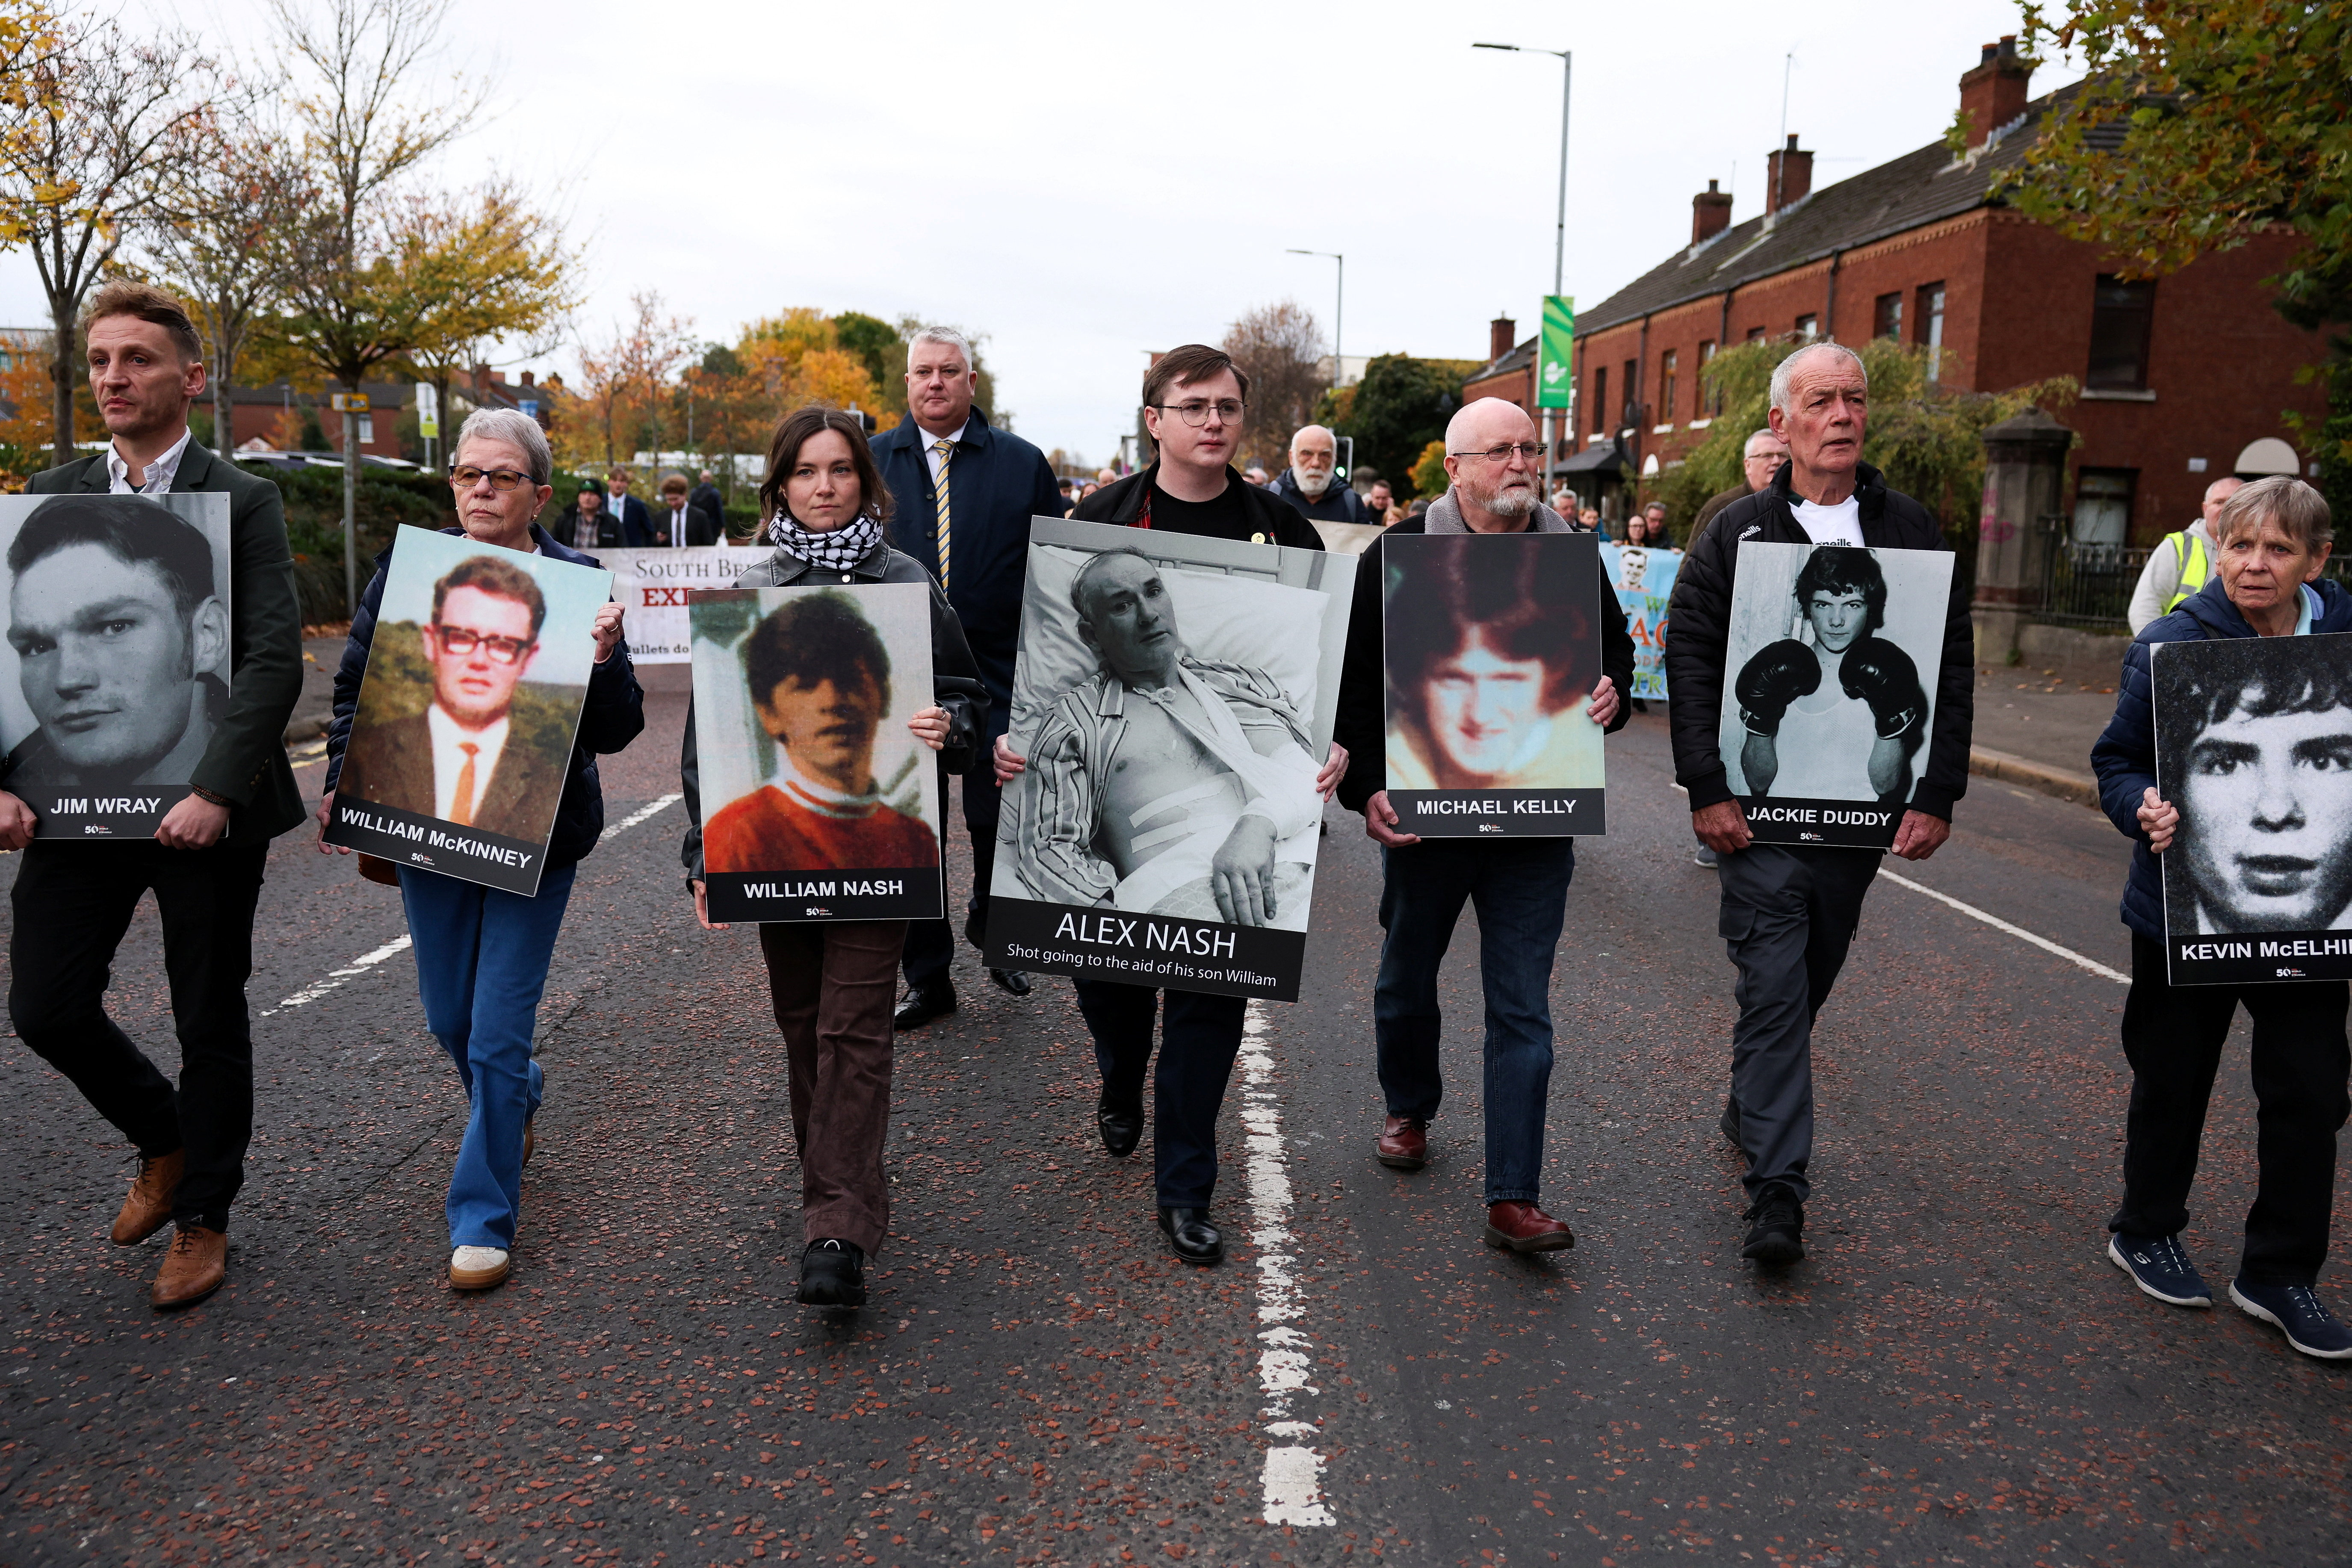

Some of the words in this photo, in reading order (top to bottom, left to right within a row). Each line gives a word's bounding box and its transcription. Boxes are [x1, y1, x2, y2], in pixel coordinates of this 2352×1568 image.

[1815, 538, 1852, 547] 'neills
[674, 643, 689, 654] do
[50, 798, 87, 814] JIM
[95, 798, 161, 813] WRAY
[1417, 800, 1508, 814] MICHAEL
[1513, 800, 1577, 813] KELLY
[1746, 807, 1817, 823] JACKIE
[1823, 810, 1892, 826] DUDDY
[342, 807, 425, 842] WILLIAM
[428, 830, 532, 868] McKINNEY
[411, 853, 423, 862] 50
[743, 881, 836, 898] WILLIAM
[843, 880, 903, 896] NASH
[1055, 913, 1138, 947] ALEX
[1146, 922, 1235, 959] NASH
[2182, 942, 2252, 960] KEVIN
[1007, 943, 1040, 960] Shot
[1043, 949, 1084, 967] going
[1087, 954, 1102, 966] to
[1105, 954, 1129, 969] the
[1132, 959, 1153, 972] aid
[1157, 961, 1173, 974] of
[1175, 963, 1194, 977] his
[1197, 969, 1222, 980] son
[1226, 969, 1276, 987] William
[2276, 969, 2290, 977] 50
